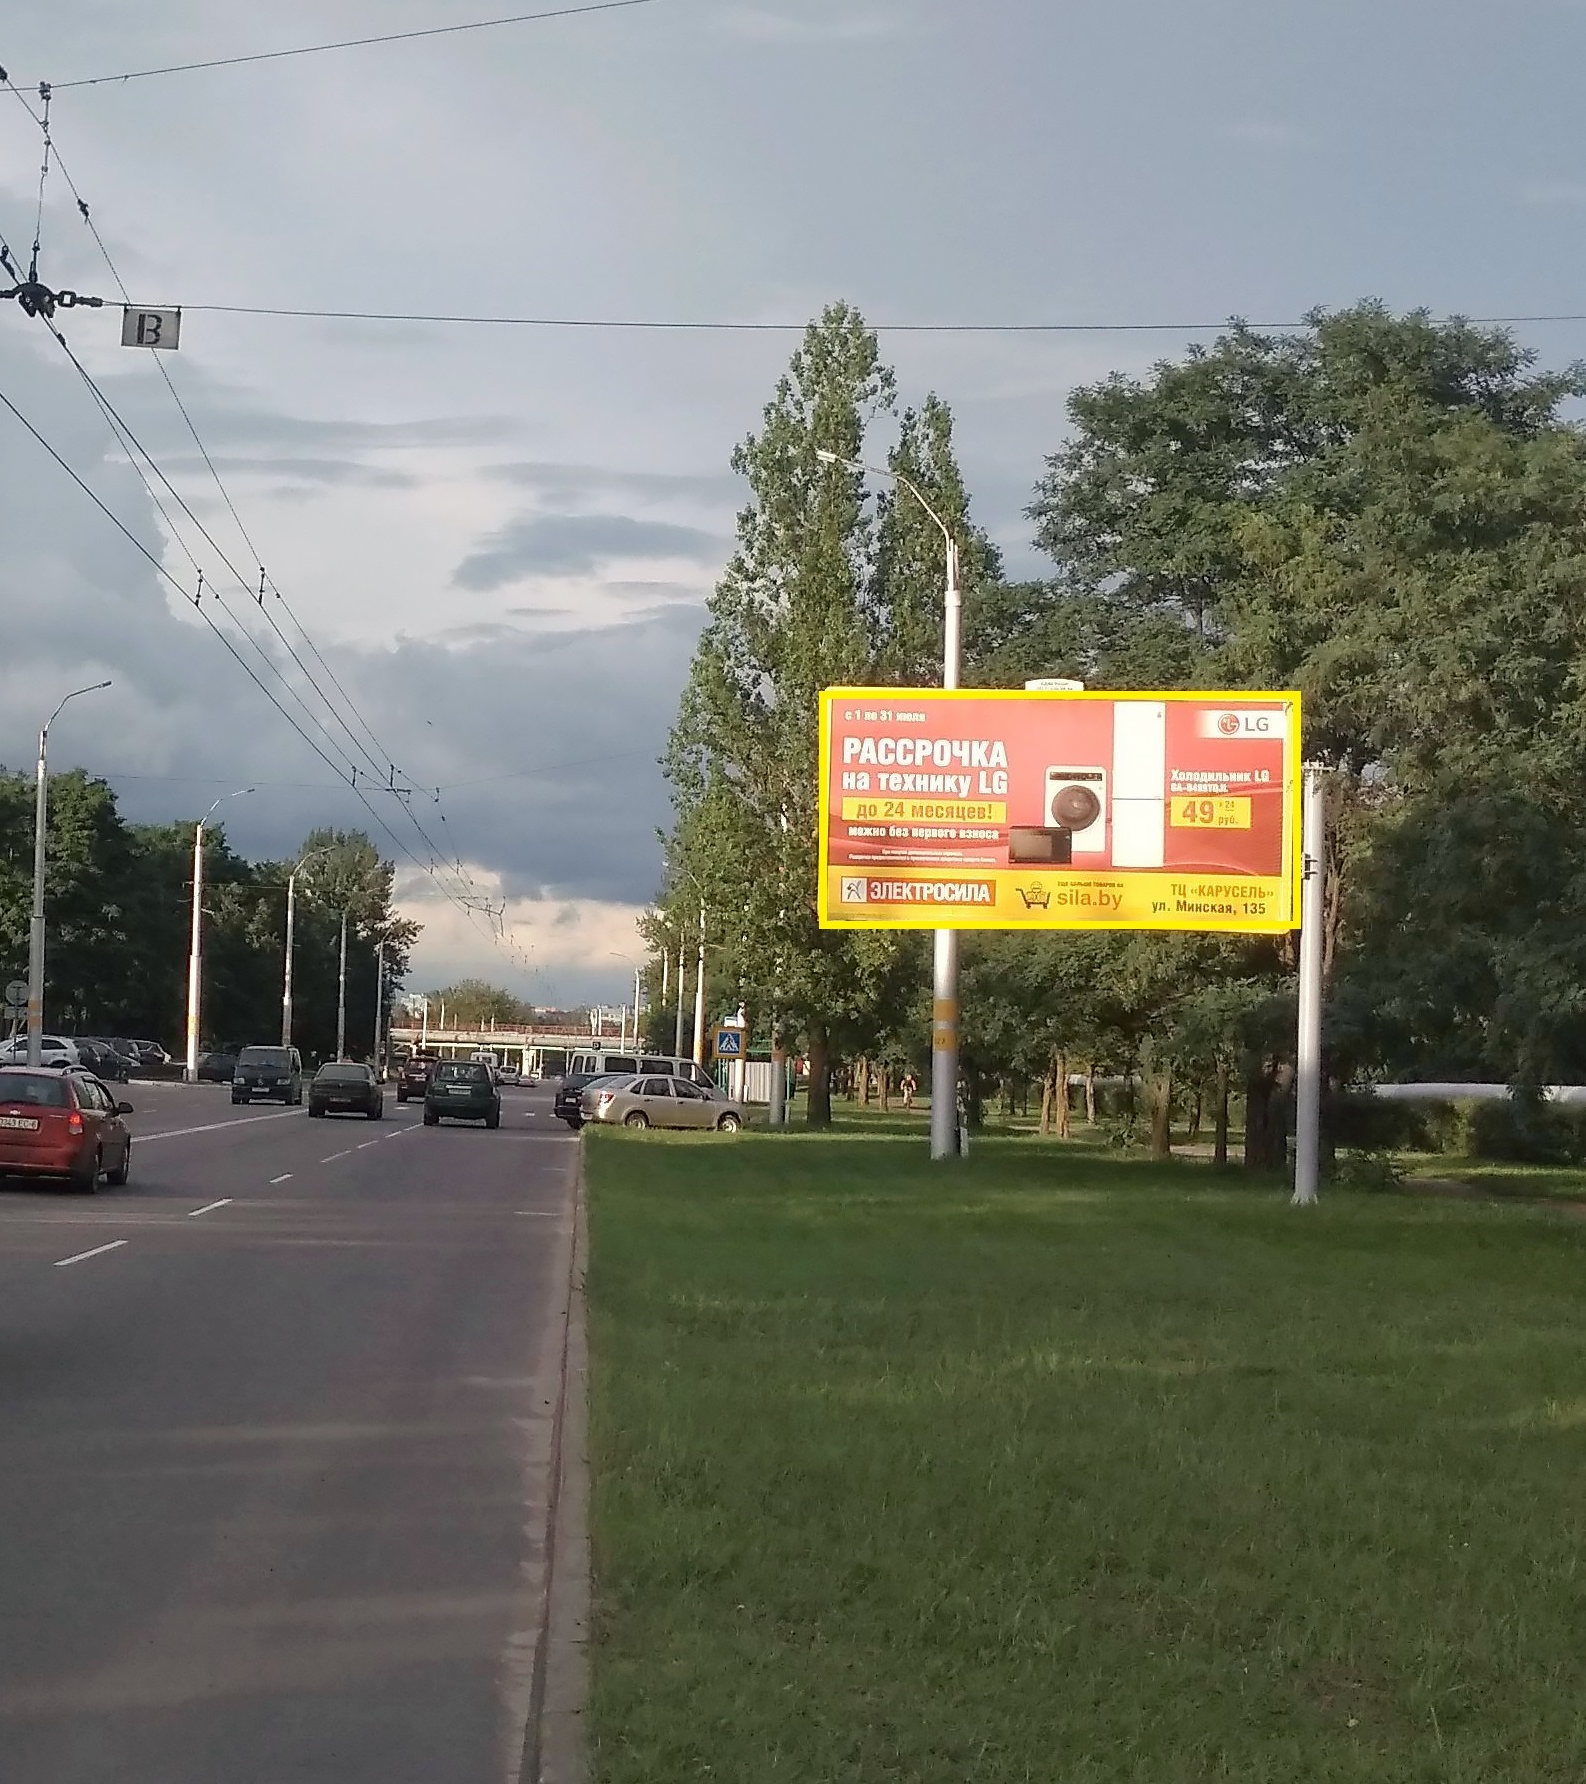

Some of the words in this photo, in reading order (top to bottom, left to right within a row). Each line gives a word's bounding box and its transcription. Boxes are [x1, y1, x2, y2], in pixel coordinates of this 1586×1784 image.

[855, 710, 861, 721] 1
[880, 710, 893, 721] 31
[1245, 717, 1269, 731] LG
[843, 736, 1008, 768] РАССРОЧКА
[842, 772, 870, 790] на
[877, 772, 972, 797] технику
[978, 770, 1008, 794] LG
[1171, 769, 1251, 783] Холодильник
[1254, 770, 1270, 782] LG
[856, 804, 877, 819] до
[884, 801, 905, 817] 24
[912, 804, 993, 821] месяцев!
[1182, 800, 1215, 824] 49
[848, 826, 886, 837] можно
[889, 825, 909, 838] без
[912, 828, 957, 840] первого
[960, 829, 1000, 840] взноса
[870, 881, 990, 903] ЭЛЕКТРОСИЛА
[1057, 889, 1123, 911] sila.by
[1171, 884, 1187, 898] ТЦ
[1191, 884, 1274, 899] «КАРУСЕЛЬ»
[1152, 901, 1171, 913] ул.
[1176, 900, 1237, 915] Минская,
[1243, 902, 1266, 914] 135
